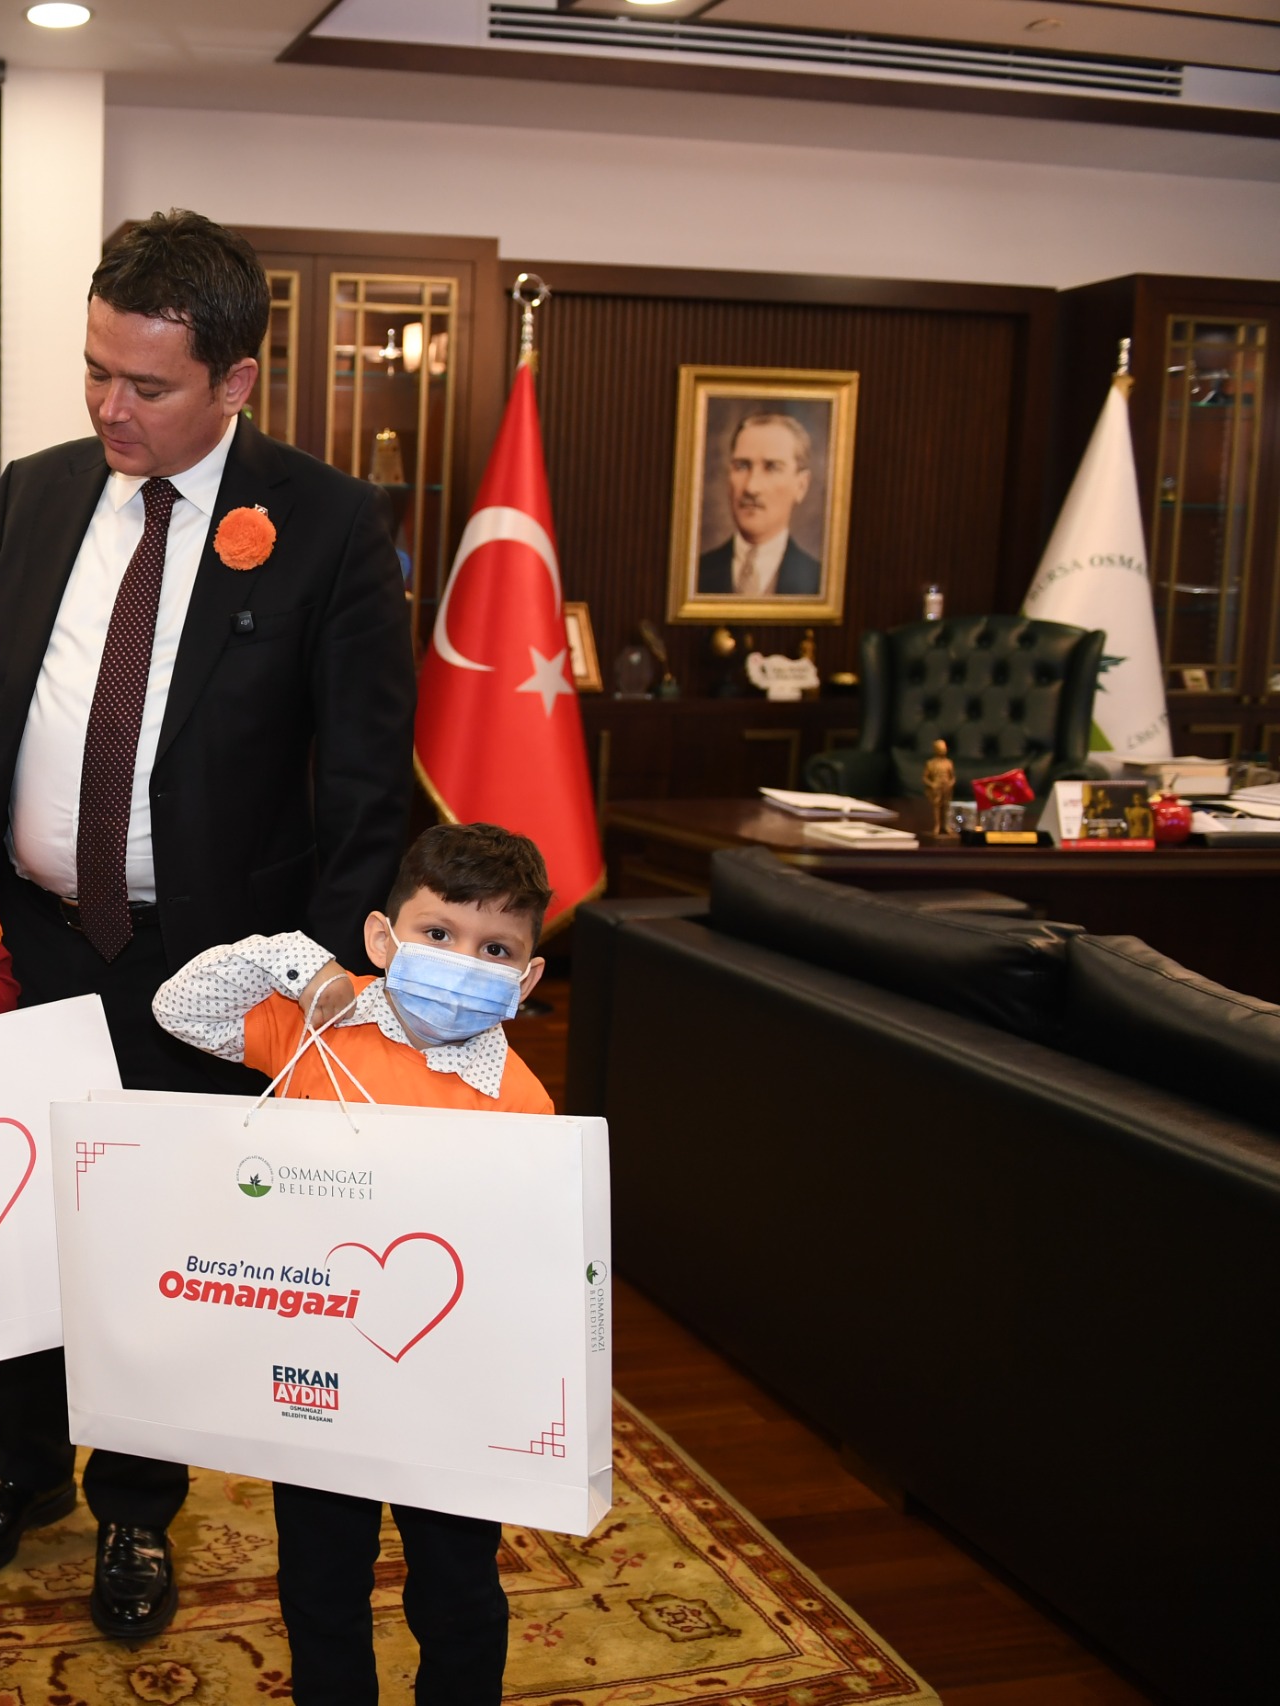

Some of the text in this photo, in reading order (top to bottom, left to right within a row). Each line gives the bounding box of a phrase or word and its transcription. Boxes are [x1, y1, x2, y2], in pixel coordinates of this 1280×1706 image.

[1088, 553, 1147, 577] OSMA
[278, 1165, 373, 1185] OSMANGAZİ
[279, 1182, 373, 1200] BELEDİYESİ
[186, 1255, 331, 1287] Bursa'nın Kalbi
[158, 1270, 360, 1319] Osmangazi
[272, 1364, 339, 1390] ERKAN
[275, 1383, 336, 1408] AYDIN
[281, 1411, 333, 1423] BELEDİYE BAŞKANI
[289, 1405, 323, 1415] OSMANGAZİ
